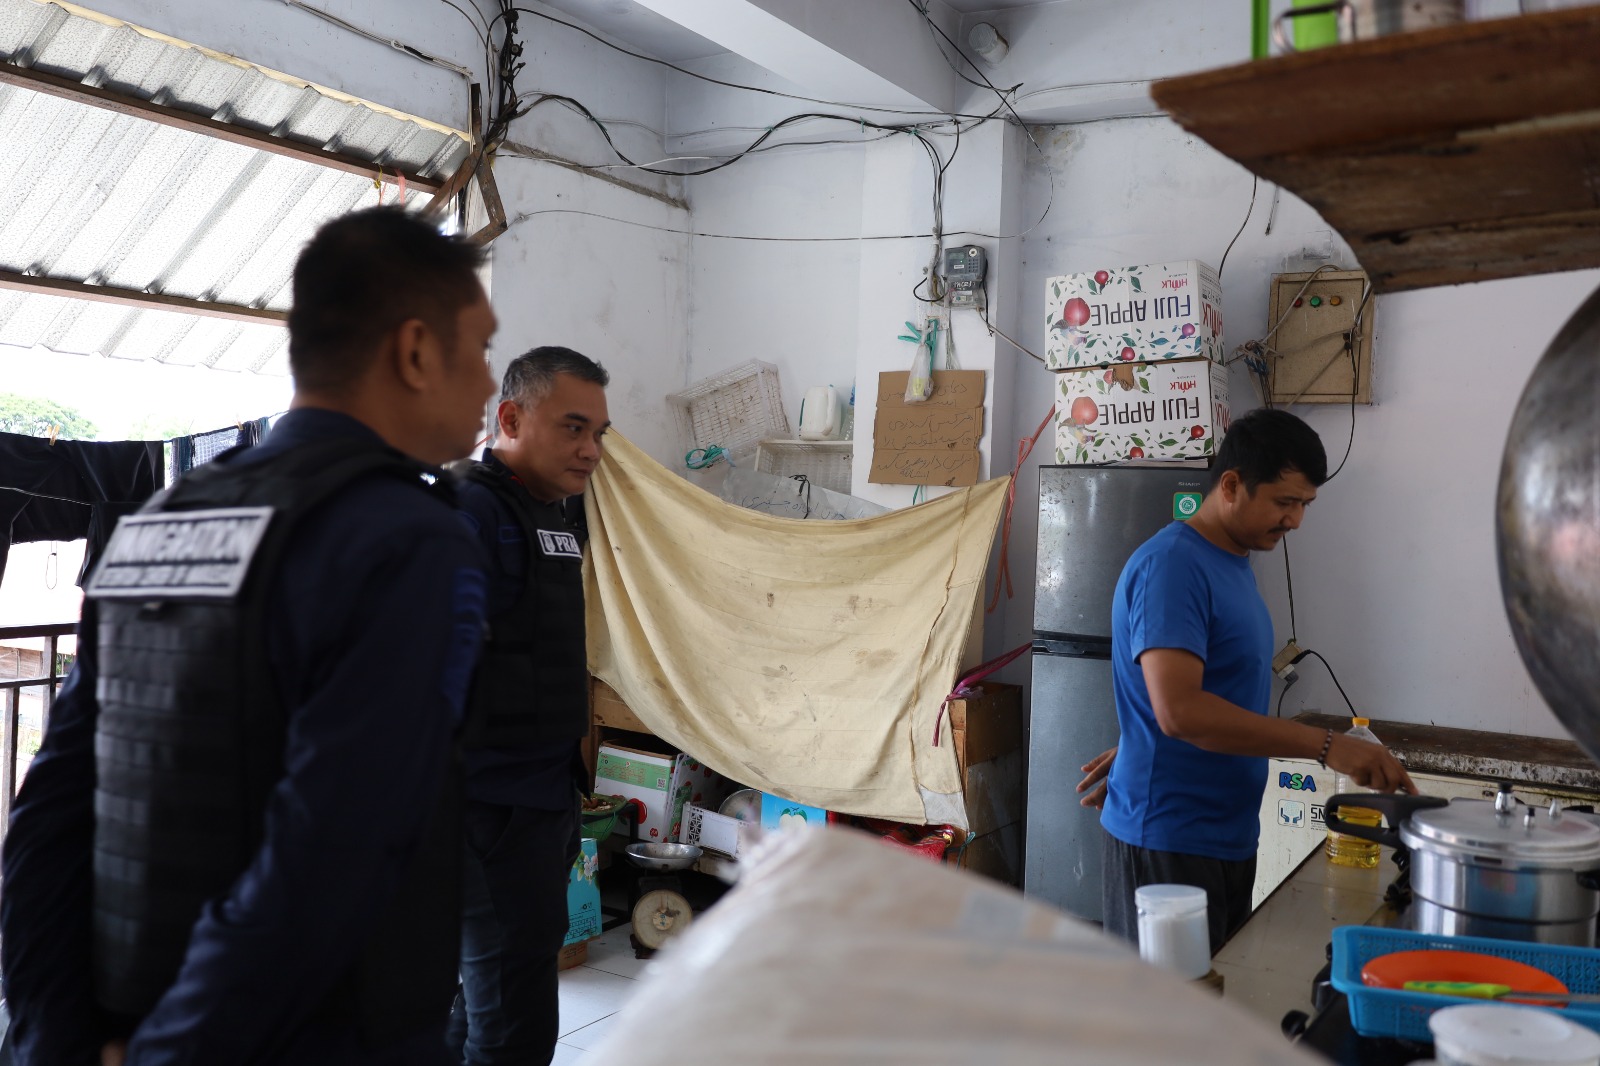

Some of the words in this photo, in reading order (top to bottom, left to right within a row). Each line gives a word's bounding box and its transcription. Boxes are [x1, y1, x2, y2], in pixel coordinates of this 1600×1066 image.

[1091, 300, 1147, 326] APPLE
[1154, 295, 1191, 319] FUJI
[1099, 400, 1155, 426] APPLE
[1162, 397, 1200, 421] FUJI
[1278, 771, 1317, 792] RSA
